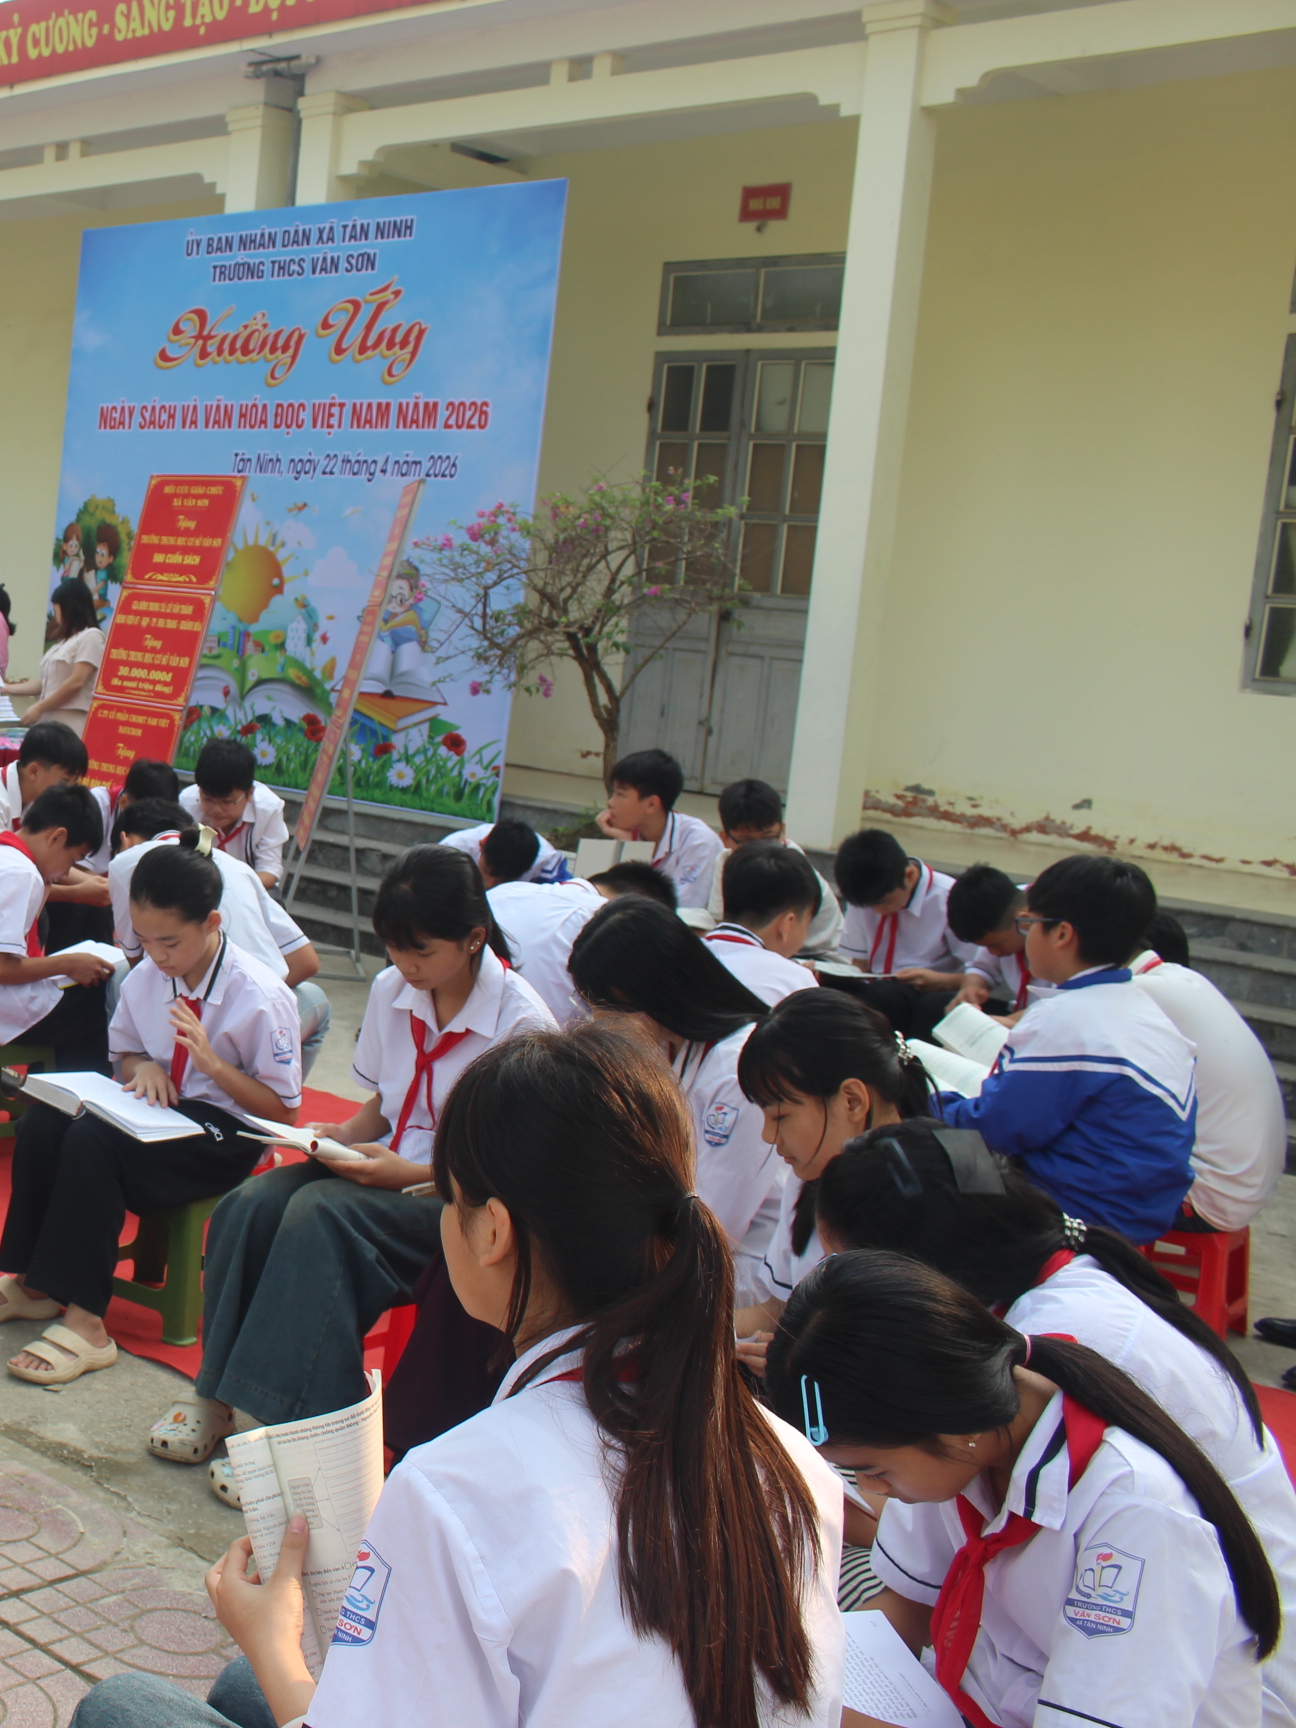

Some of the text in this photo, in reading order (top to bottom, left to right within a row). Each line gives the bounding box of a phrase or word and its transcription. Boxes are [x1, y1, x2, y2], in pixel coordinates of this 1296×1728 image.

[26, 8, 98, 60] CƯƠNG
[185, 217, 415, 258] ỦY BAN NHÂN DÂN XÃ TÂN NINH
[211, 250, 378, 284] TRƯỜNG THCS VÂN SƠN
[154, 275, 431, 387] Hưởng Ứng
[97, 394, 490, 436] NGÀY SÁCH VÀ VĂN HÓA ĐỌC VIỆT NAM NĂM 2026
[232, 451, 459, 483] Tân Ninh, ngày 22 tháng 4 năm 2026
[346, 1612, 365, 1624] THCS
[1073, 1601, 1122, 1616] TRƯỜNG THCS
[1073, 1610, 1121, 1625] VÂN SƠN
[337, 1632, 352, 1642] NINH
[338, 1619, 362, 1635] SƠN
[1097, 1624, 1113, 1632] NINH
